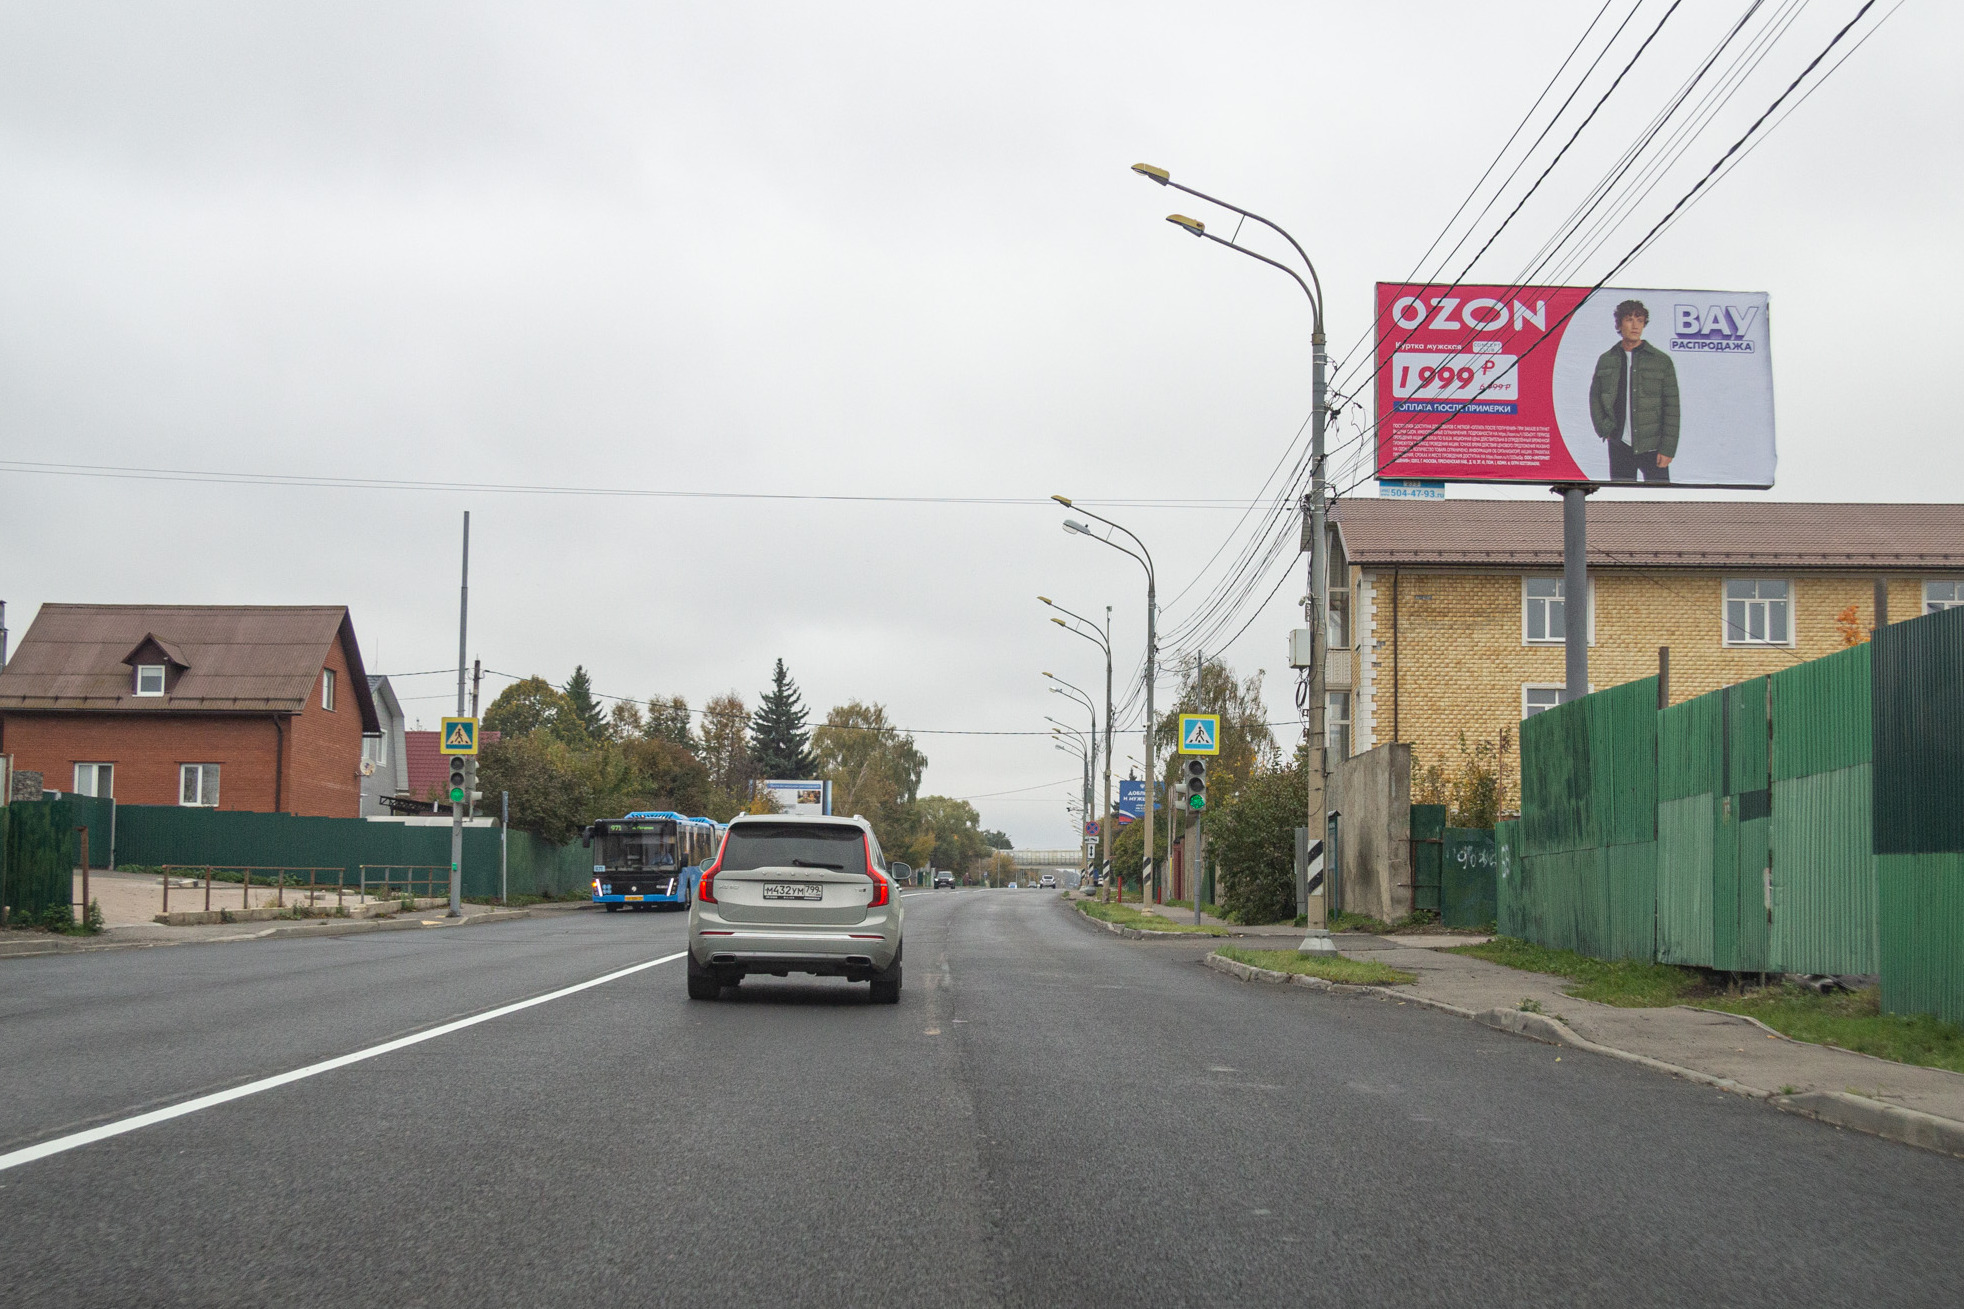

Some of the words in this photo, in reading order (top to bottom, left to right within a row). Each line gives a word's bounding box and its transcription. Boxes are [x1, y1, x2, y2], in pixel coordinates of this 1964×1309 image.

[1392, 296, 1546, 332] OZON
[1674, 304, 1760, 340] ВАУ
[1395, 341, 1425, 350] Куртка
[1671, 340, 1753, 352] РАСПРОДАЖА
[1399, 403, 1433, 411] ОПЛАТА
[1434, 404, 1465, 412] ПОСЛЕ
[1465, 404, 1511, 413] ПРИМЕРКИ
